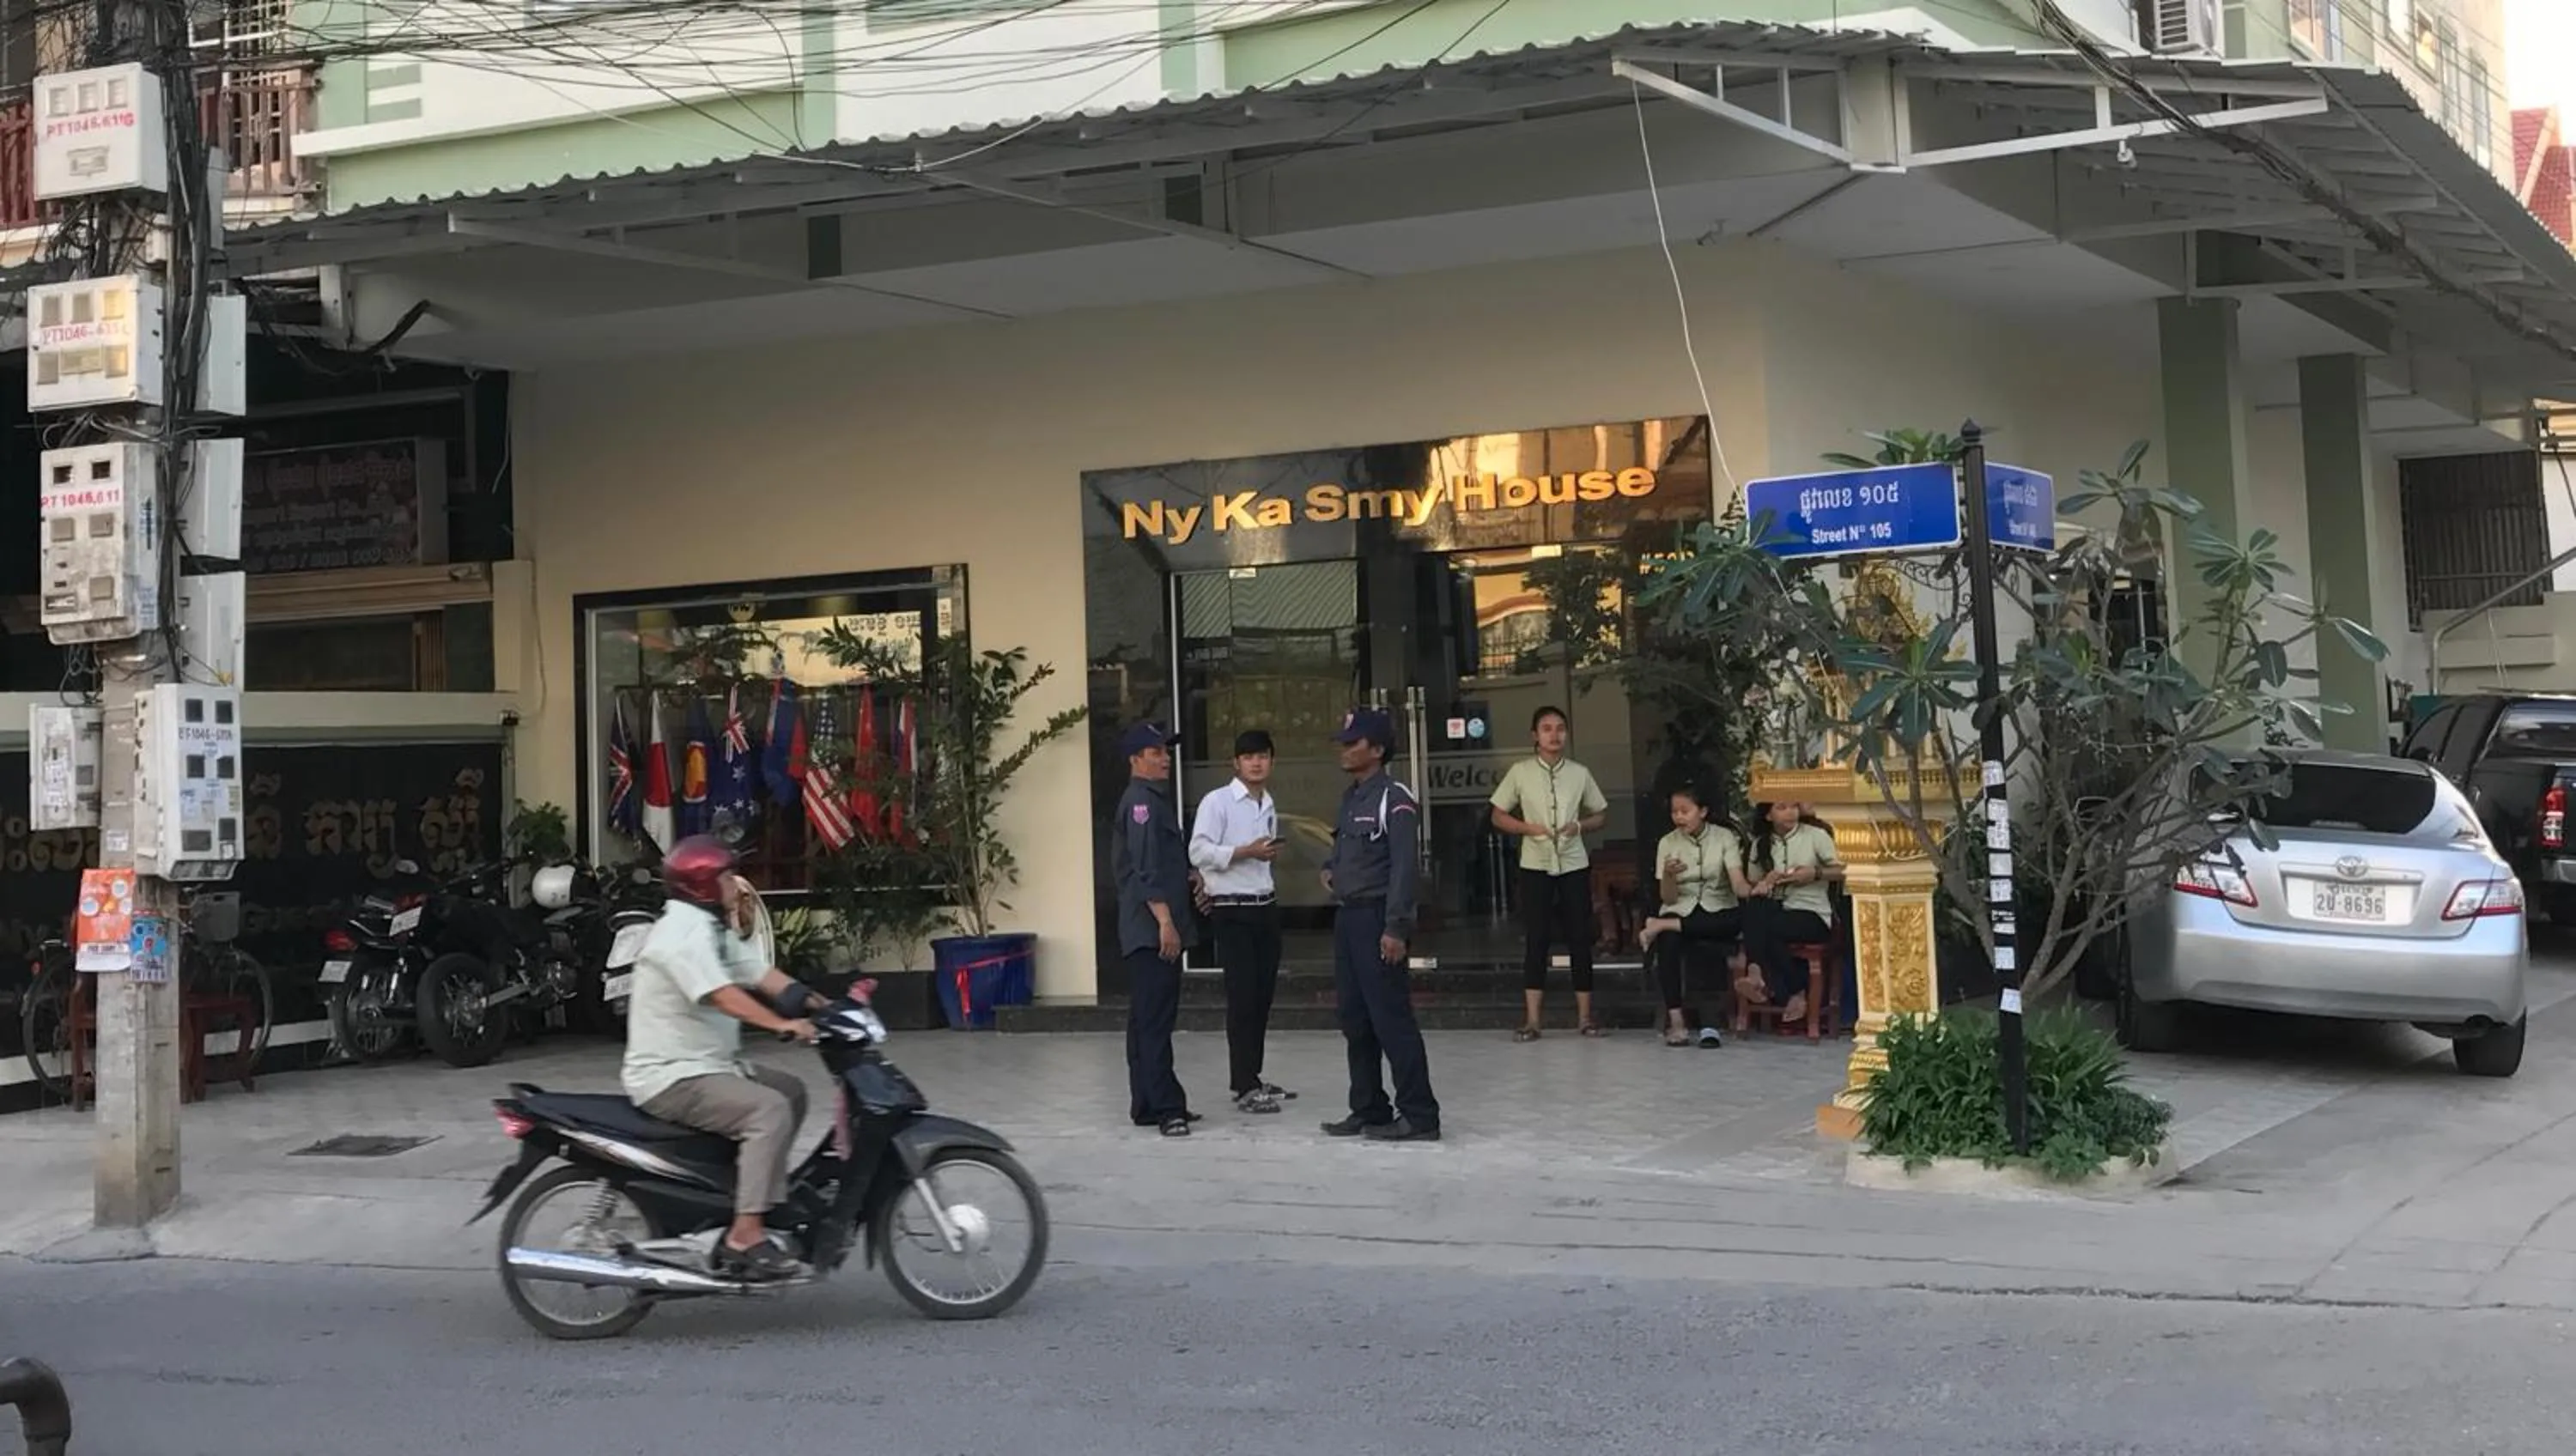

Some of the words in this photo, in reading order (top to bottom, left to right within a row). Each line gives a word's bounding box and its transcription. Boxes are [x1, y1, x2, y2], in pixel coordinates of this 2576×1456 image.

[1122, 500, 1202, 545] Ny
[1212, 488, 1292, 531] Ka
[1304, 483, 1443, 526] Smy
[1453, 465, 1657, 510] House
[1811, 526, 1847, 545] Street
[1869, 522, 1893, 539] 105
